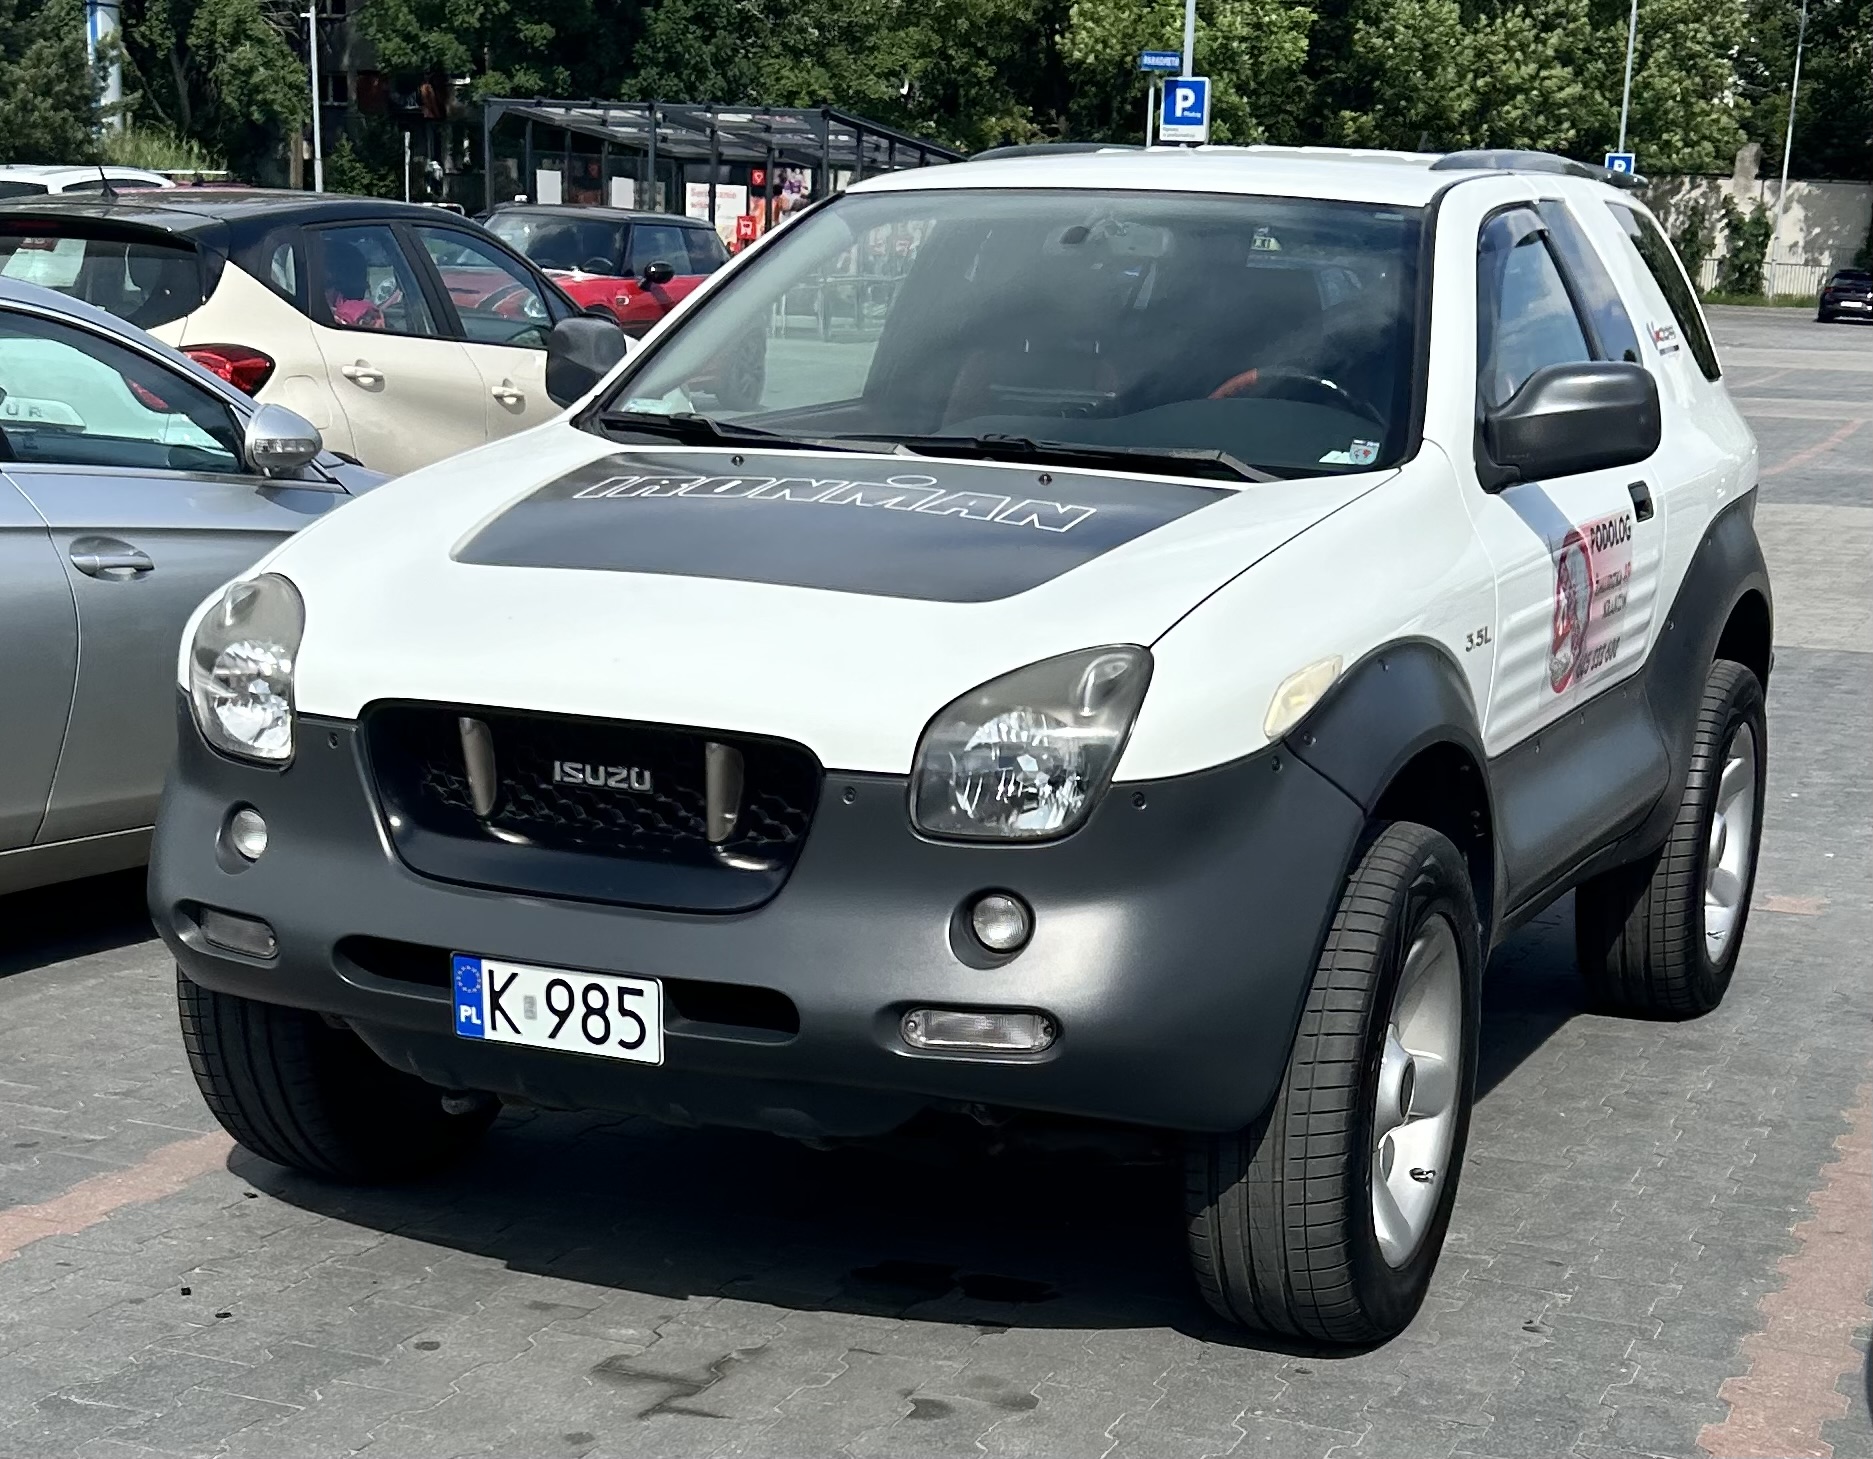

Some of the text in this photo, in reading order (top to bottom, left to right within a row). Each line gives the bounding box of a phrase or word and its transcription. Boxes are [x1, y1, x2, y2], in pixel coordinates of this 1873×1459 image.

[1175, 87, 1196, 117] P
[1613, 160, 1627, 172] P
[572, 475, 1097, 532] IRONMAN
[1590, 514, 1632, 555] PODOLOG
[1465, 625, 1492, 652] 3.5L
[553, 760, 651, 791] ISUZU
[459, 1005, 481, 1025] PL
[488, 969, 647, 1050] K 985
